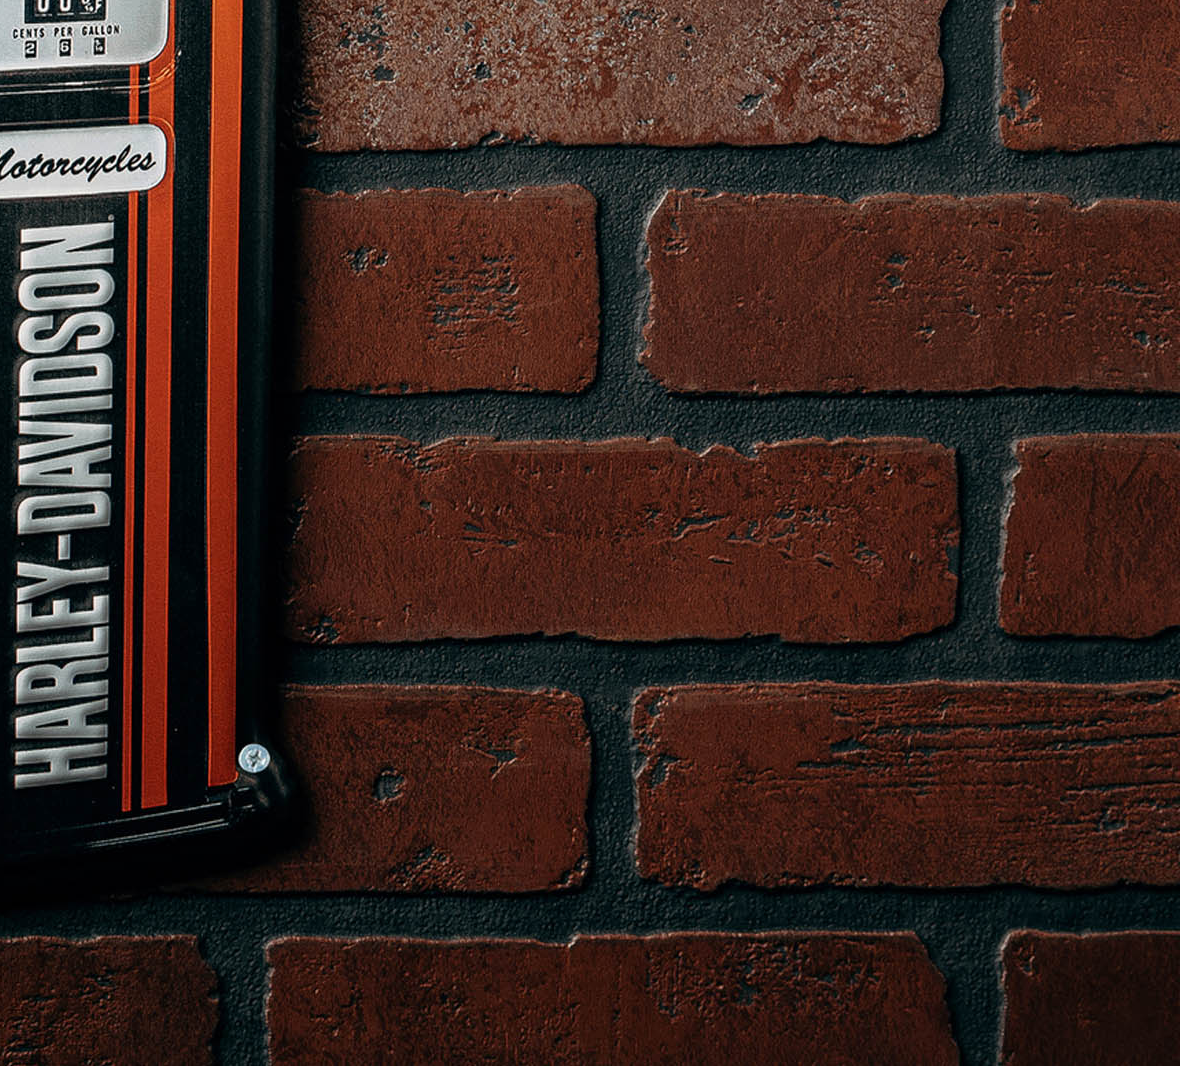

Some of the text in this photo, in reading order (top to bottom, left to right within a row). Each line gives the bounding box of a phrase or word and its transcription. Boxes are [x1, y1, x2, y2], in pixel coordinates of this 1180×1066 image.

[12, 25, 120, 39] CENTS PER GALLON
[15, 221, 115, 789] HARLEY-DAVIDSON
